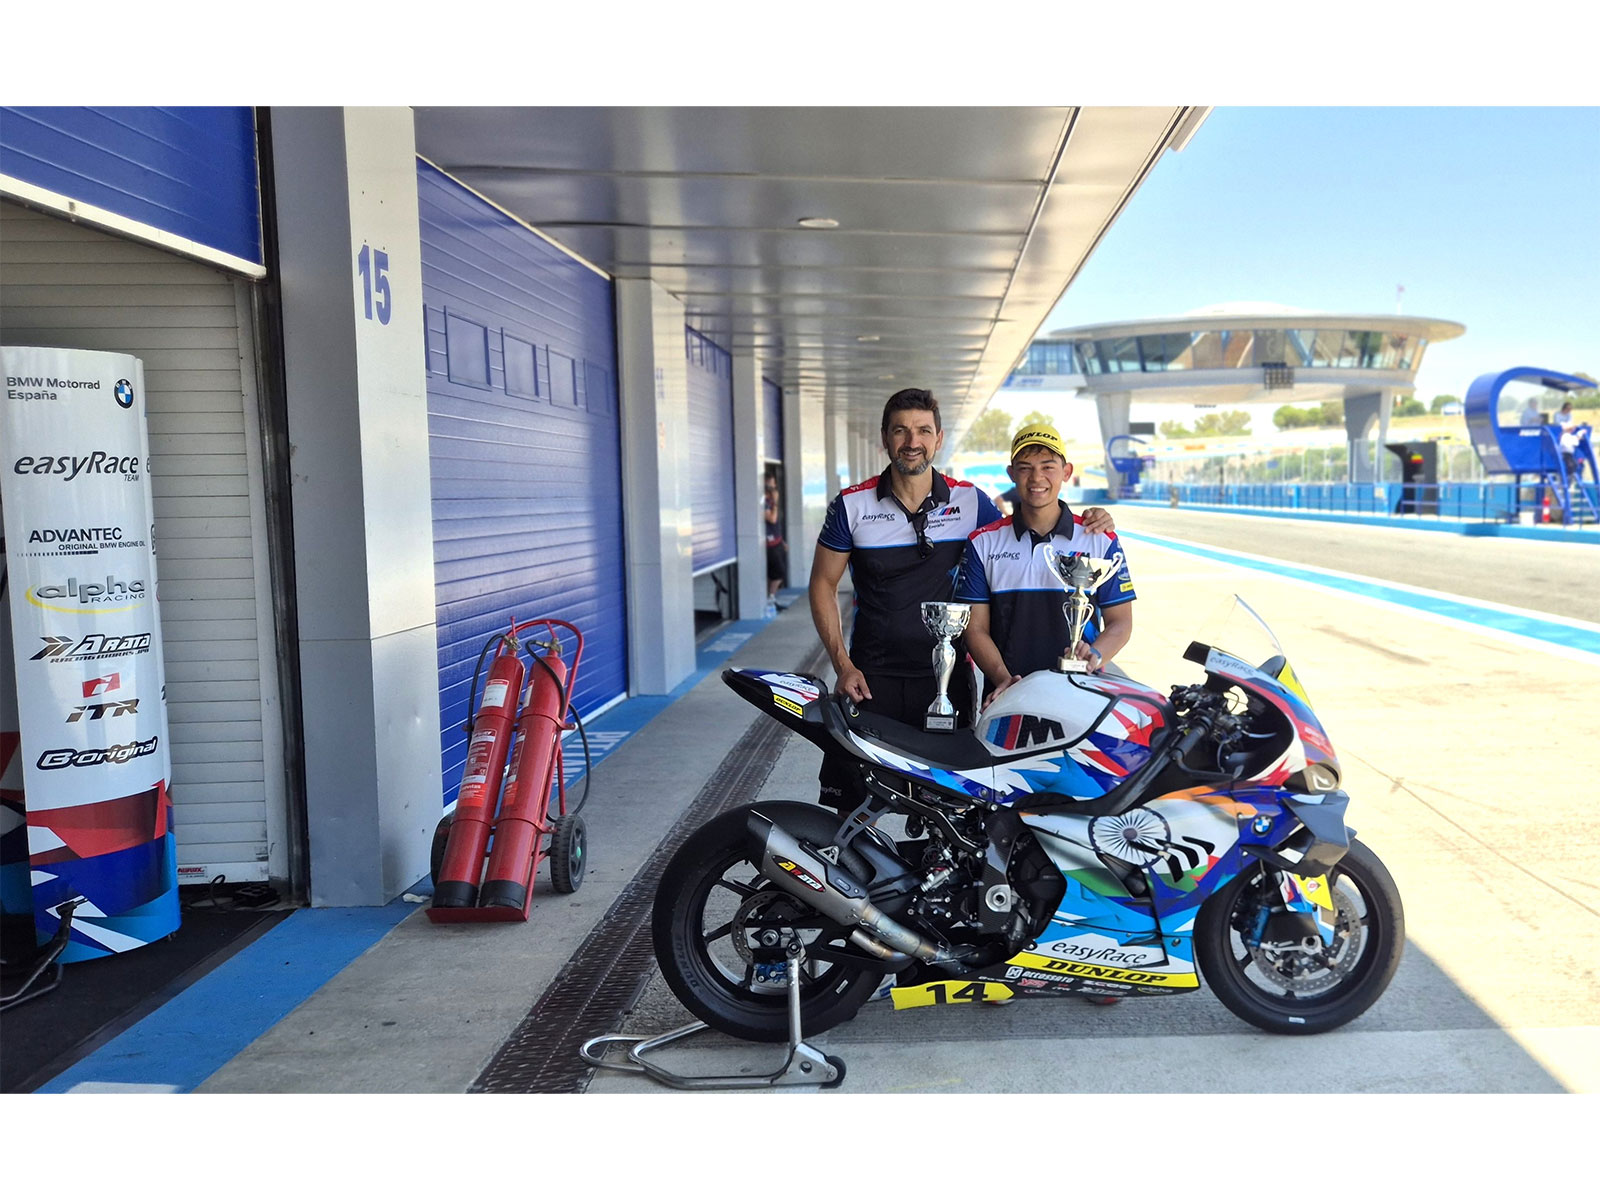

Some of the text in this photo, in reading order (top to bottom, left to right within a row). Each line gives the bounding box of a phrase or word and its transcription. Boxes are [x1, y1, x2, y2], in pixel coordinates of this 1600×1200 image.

[357, 244, 391, 326] 15
[7, 377, 100, 390] BMW Motorrad
[8, 389, 58, 402] España
[1014, 431, 1058, 446] DUNLOP
[13, 451, 139, 482] easyRace
[123, 474, 140, 482] TEAM
[28, 527, 123, 543] ADVANTEC
[58, 543, 99, 551] ORIGINAL
[118, 541, 139, 549] ENGINE
[36, 575, 145, 604] alpha
[90, 592, 146, 604] RACING
[1015, 714, 1066, 750] M
[1051, 941, 1148, 964] easyRace
[1043, 959, 1168, 985] DUNLOP
[926, 982, 989, 1005] 14
